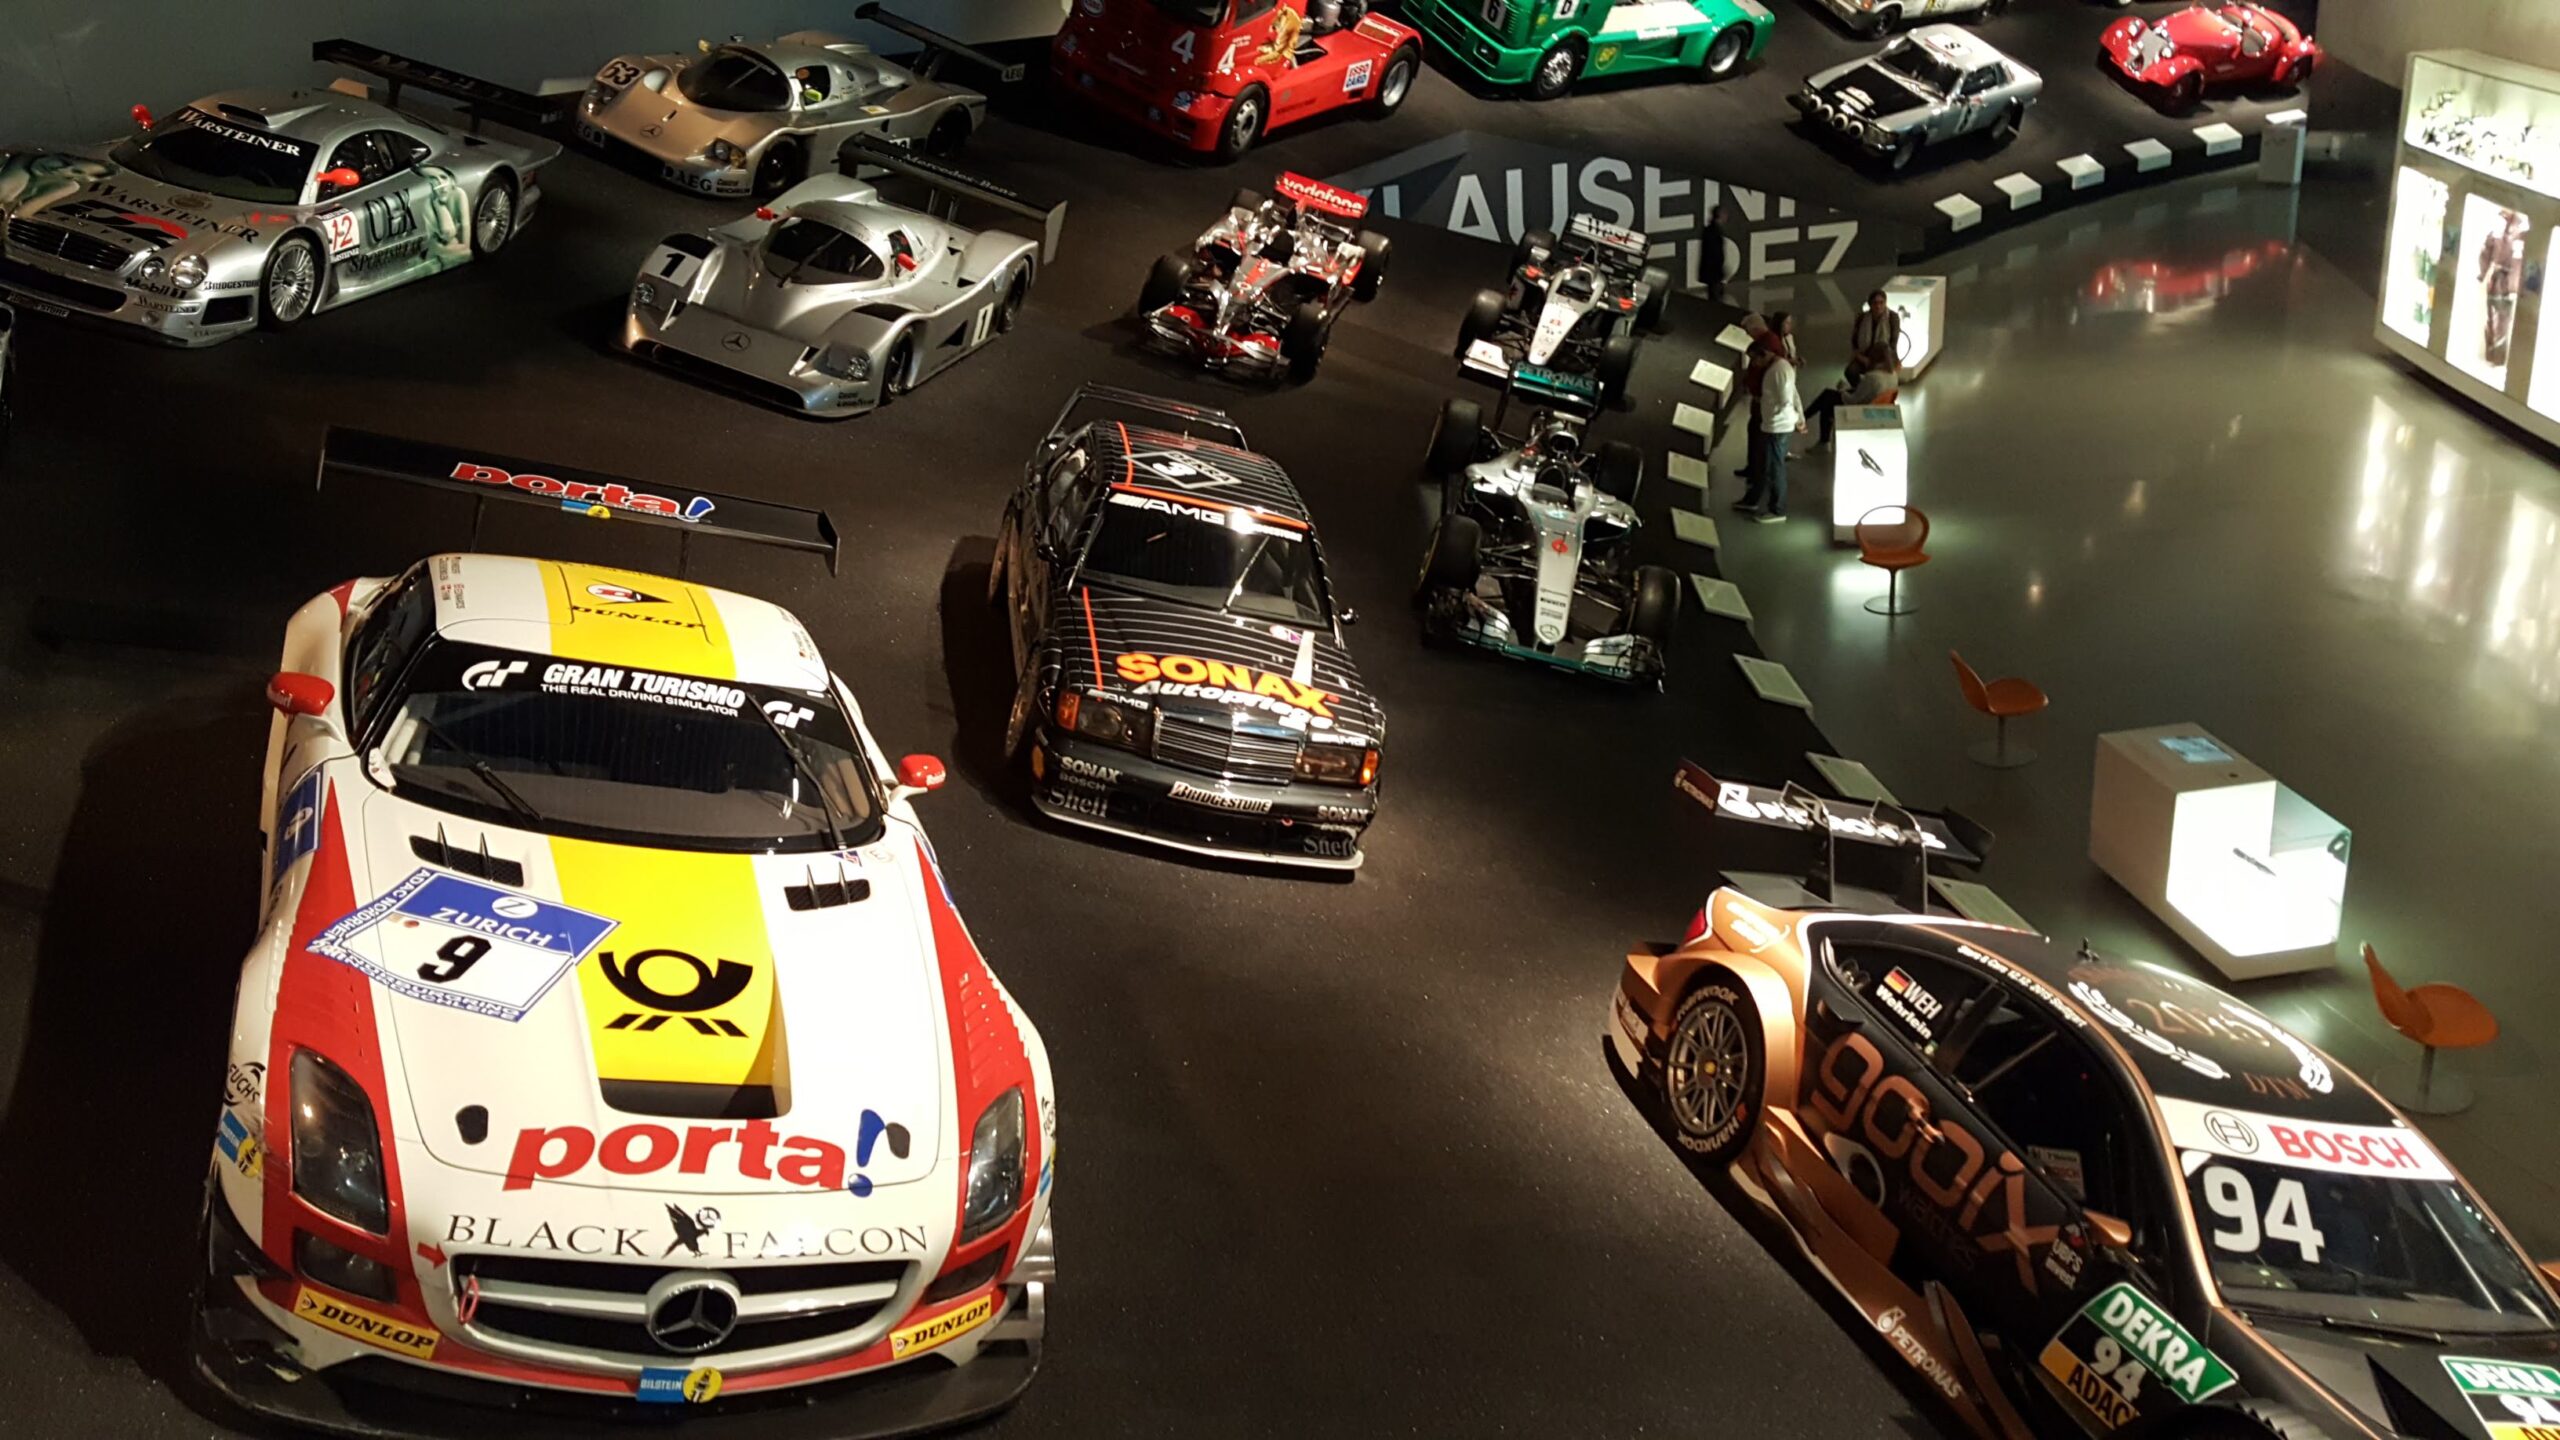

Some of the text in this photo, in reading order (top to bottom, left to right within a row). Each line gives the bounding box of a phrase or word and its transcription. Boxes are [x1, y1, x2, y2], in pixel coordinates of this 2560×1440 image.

[1171, 30, 1196, 64] 4
[1217, 43, 1236, 70] 4
[602, 60, 641, 86] 63
[178, 109, 300, 157] WARSTEINER
[88, 182, 260, 244] WARSTEINER
[1280, 175, 1364, 214] vodafone
[331, 215, 353, 251] 12
[1588, 215, 1631, 245] West
[663, 252, 687, 278] 1
[124, 276, 170, 298] Mobil
[1516, 362, 1595, 391] PETRONAS
[449, 462, 716, 523] porta!
[1144, 498, 1225, 526] AMG
[571, 604, 706, 628] DUNLOP
[541, 683, 739, 718] THE REAL DRIVING SIMULATOR
[543, 663, 746, 709] GRAN TURISMO
[1115, 651, 1335, 718] SONAX
[1059, 772, 1107, 791] BOSCH
[1060, 756, 1120, 784] SONAX
[1047, 787, 1108, 818] Shell
[1318, 805, 1369, 822] SONAX
[393, 868, 431, 898] ADAC
[429, 906, 553, 949] ZURICH
[416, 934, 493, 985] 9
[1875, 983, 1932, 1040] Wehrlein
[1904, 980, 1944, 1021] WEH
[229, 1062, 261, 1104] FUCHS
[502, 1109, 887, 1199] porta!
[2267, 1124, 2422, 1170] BOSCH
[2202, 1165, 2326, 1263] 94
[444, 1214, 928, 1260] BLACK FALCON
[320, 1303, 436, 1350] DUNLOP
[912, 1300, 991, 1347] DUNLOP
[2102, 1290, 2207, 1397] DEKRA
[1890, 1324, 1963, 1399] PETRONAS
[2088, 1336, 2148, 1403] 94
[640, 1379, 683, 1391] BILSTEIN
[2067, 1361, 2135, 1428] ADAC
